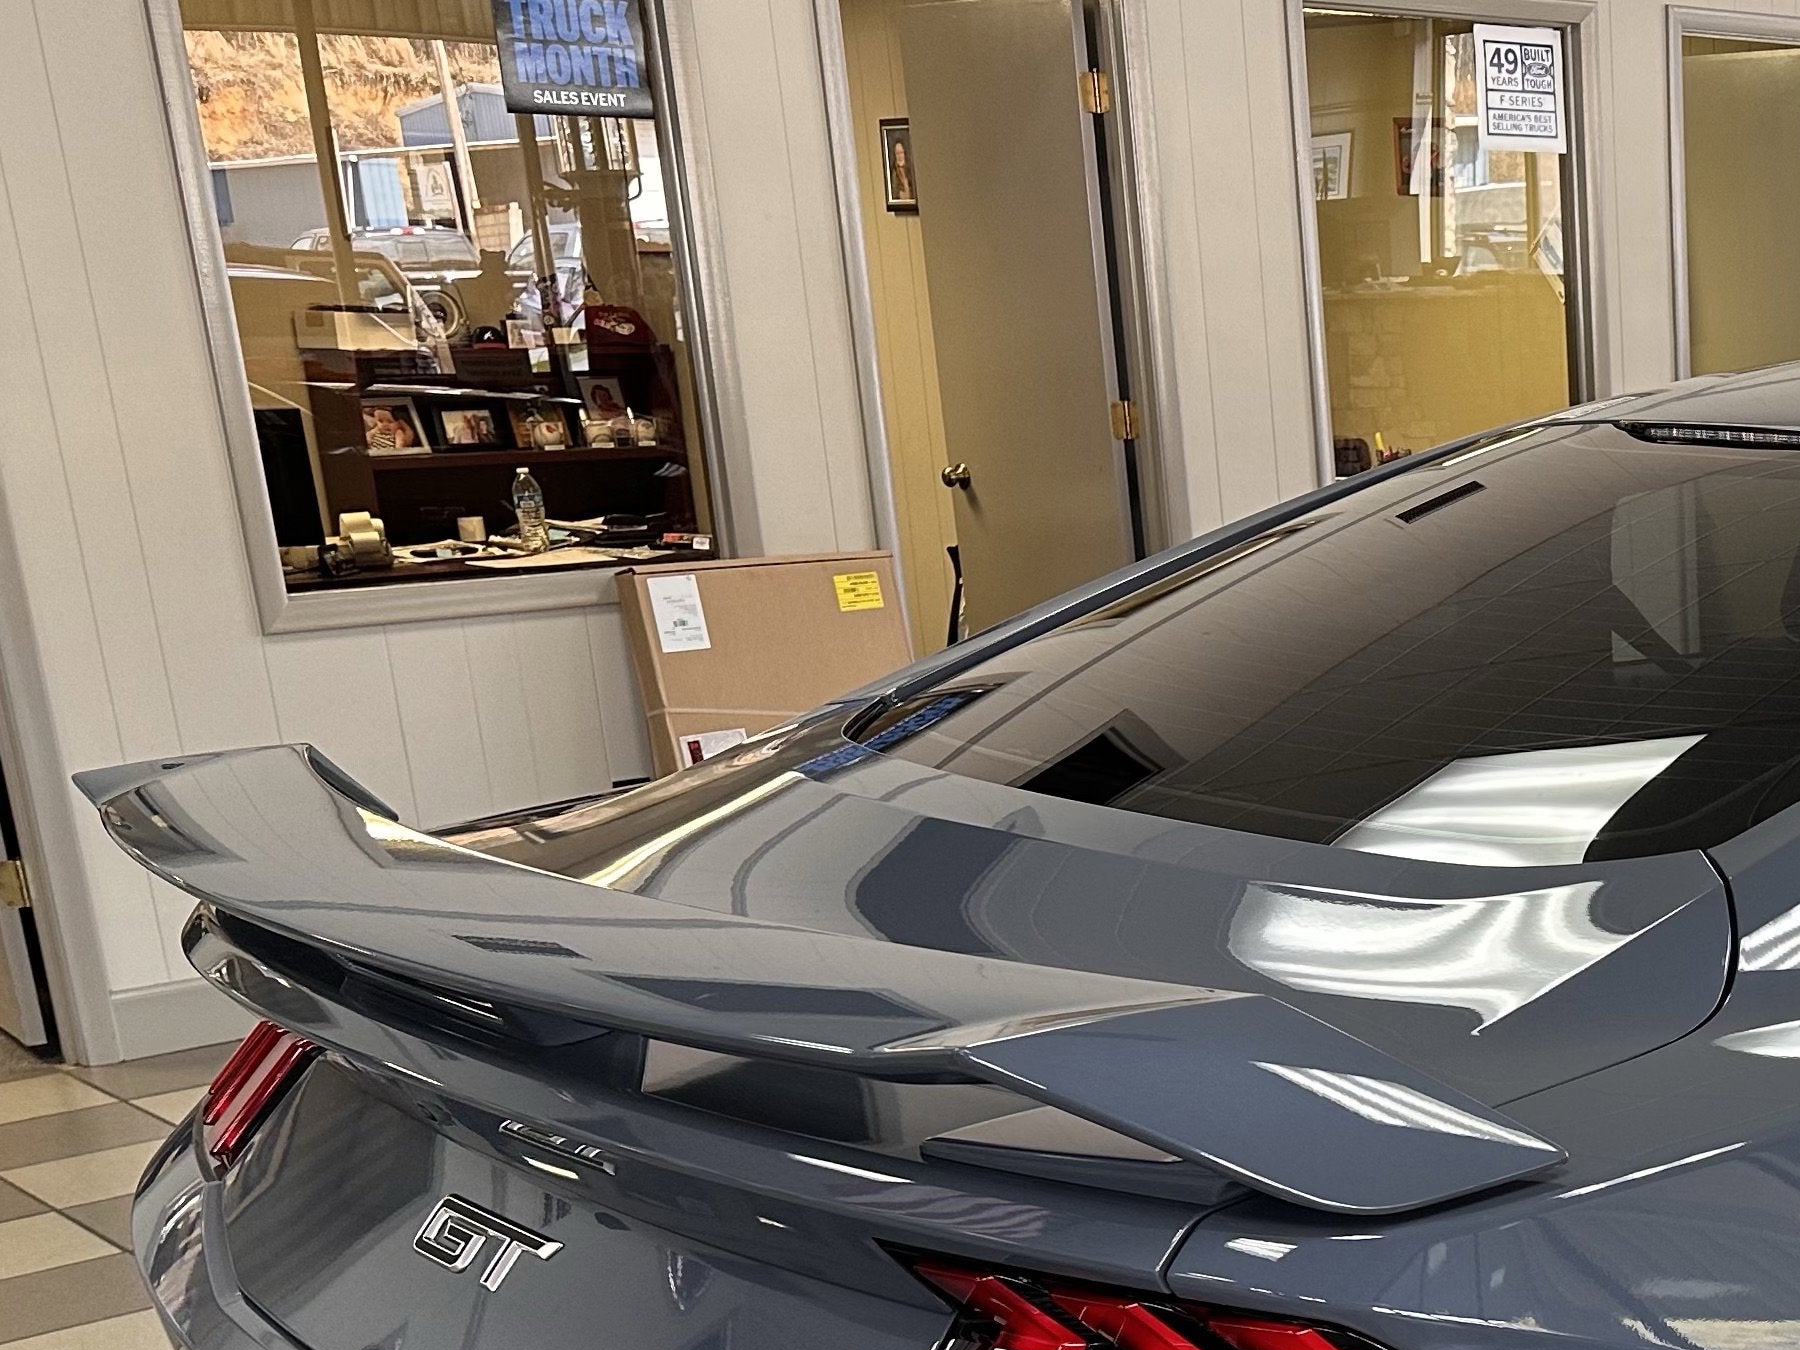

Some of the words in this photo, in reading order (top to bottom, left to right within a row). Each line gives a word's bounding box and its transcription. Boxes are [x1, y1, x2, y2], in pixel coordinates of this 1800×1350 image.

[508, 0, 634, 46] TRUCK
[1489, 47, 1518, 75] 49
[1523, 48, 1551, 62] BUILT
[514, 42, 640, 88] MONTH
[1491, 77, 1519, 87] YEARS
[1525, 78, 1552, 90] TOUGH
[533, 89, 579, 106] SALES
[581, 91, 627, 108] EVENT
[1492, 113, 1532, 123] AMERICA'S
[1533, 115, 1553, 124] BEST
[1492, 122, 1523, 131] SELLING
[1525, 123, 1553, 134] TRUCKS
[413, 1193, 565, 1292] GT
